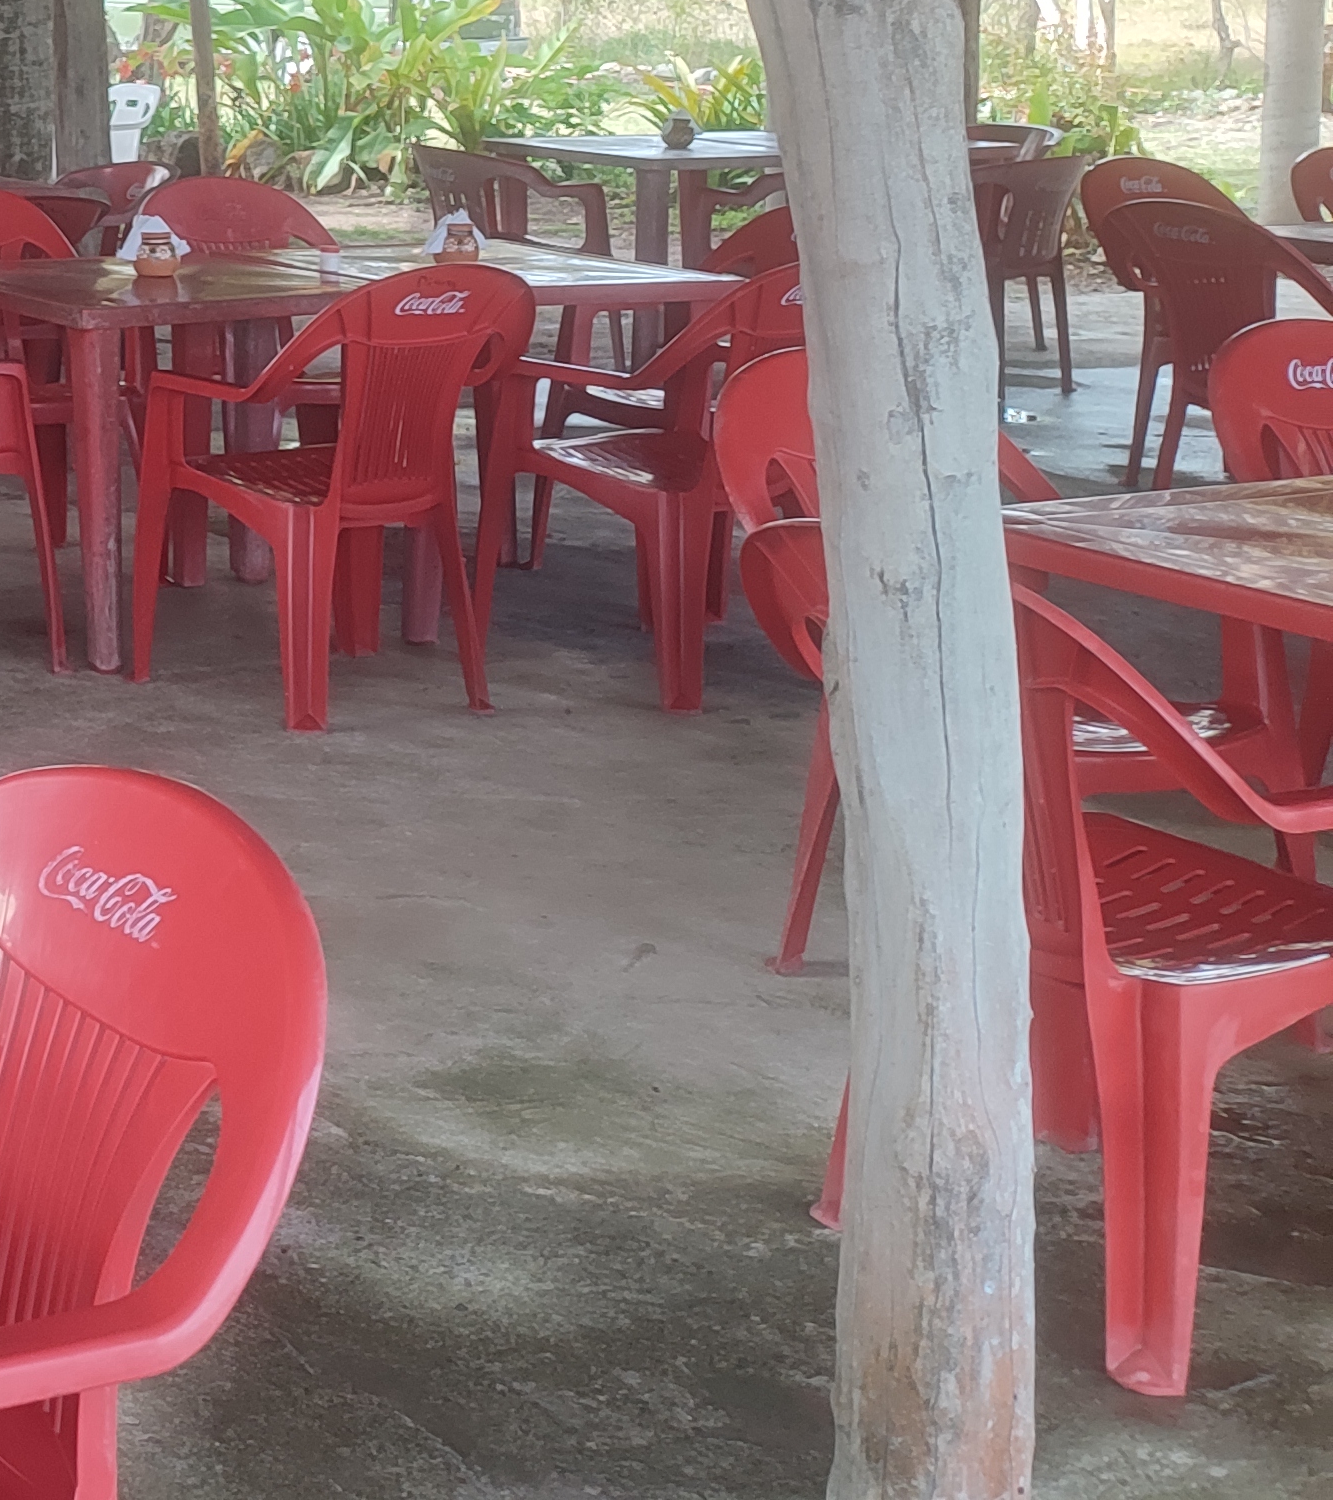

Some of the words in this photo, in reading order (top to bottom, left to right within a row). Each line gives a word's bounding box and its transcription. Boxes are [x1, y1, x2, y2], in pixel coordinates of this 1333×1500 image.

[1119, 176, 1162, 194] Coca-Cola
[1153, 221, 1210, 244] Coca-Cola
[394, 290, 472, 316] Coca-Cola
[38, 845, 179, 943] Coca-Cola
